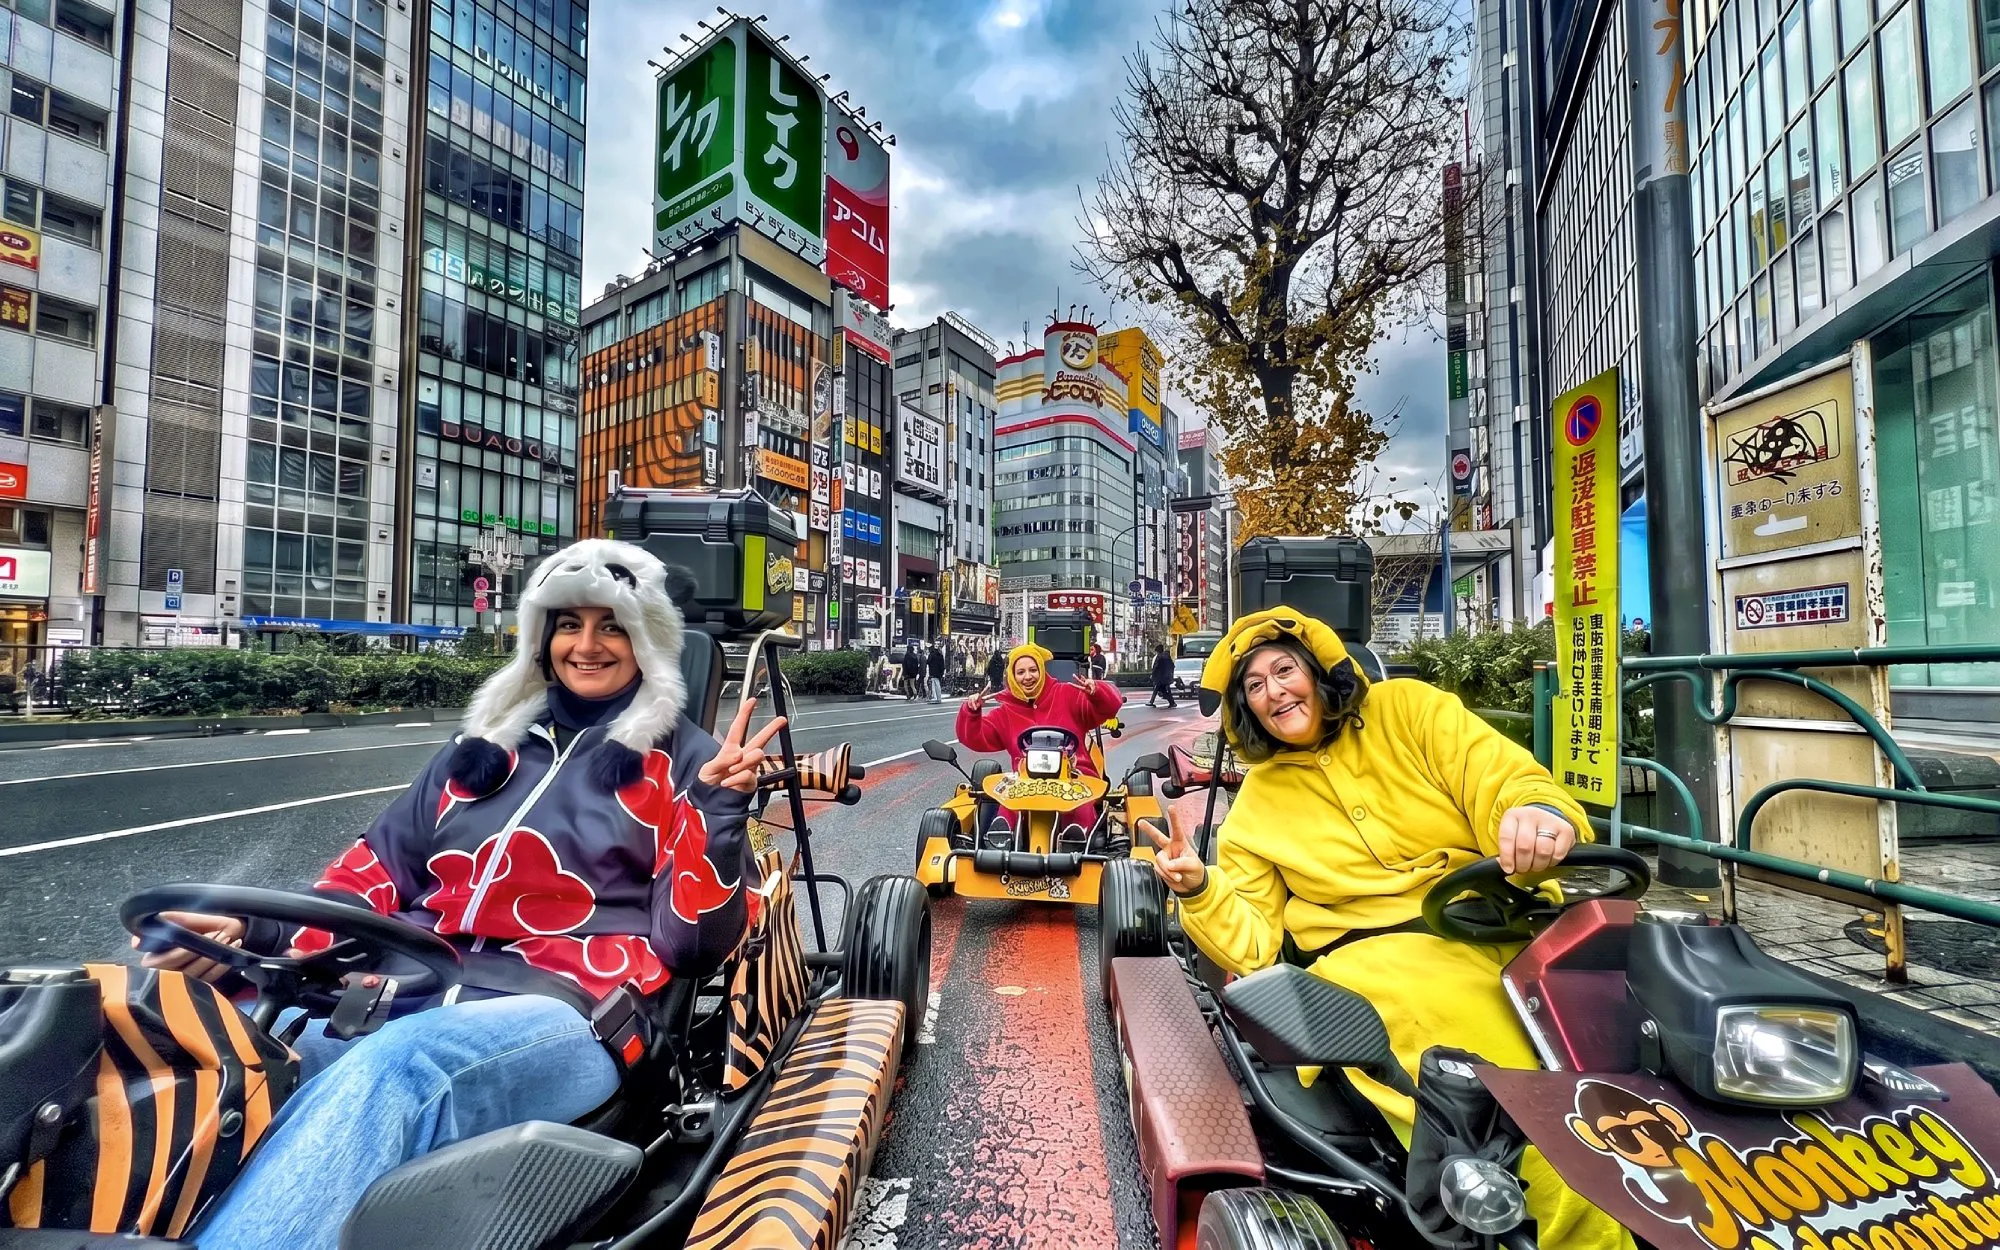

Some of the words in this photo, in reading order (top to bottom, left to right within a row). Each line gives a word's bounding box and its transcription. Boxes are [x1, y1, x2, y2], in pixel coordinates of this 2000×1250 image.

[663, 83, 720, 172] レイク
[764, 57, 800, 190] レイク
[833, 197, 885, 255] アコム
[1673, 1112, 1986, 1249] Monkey
